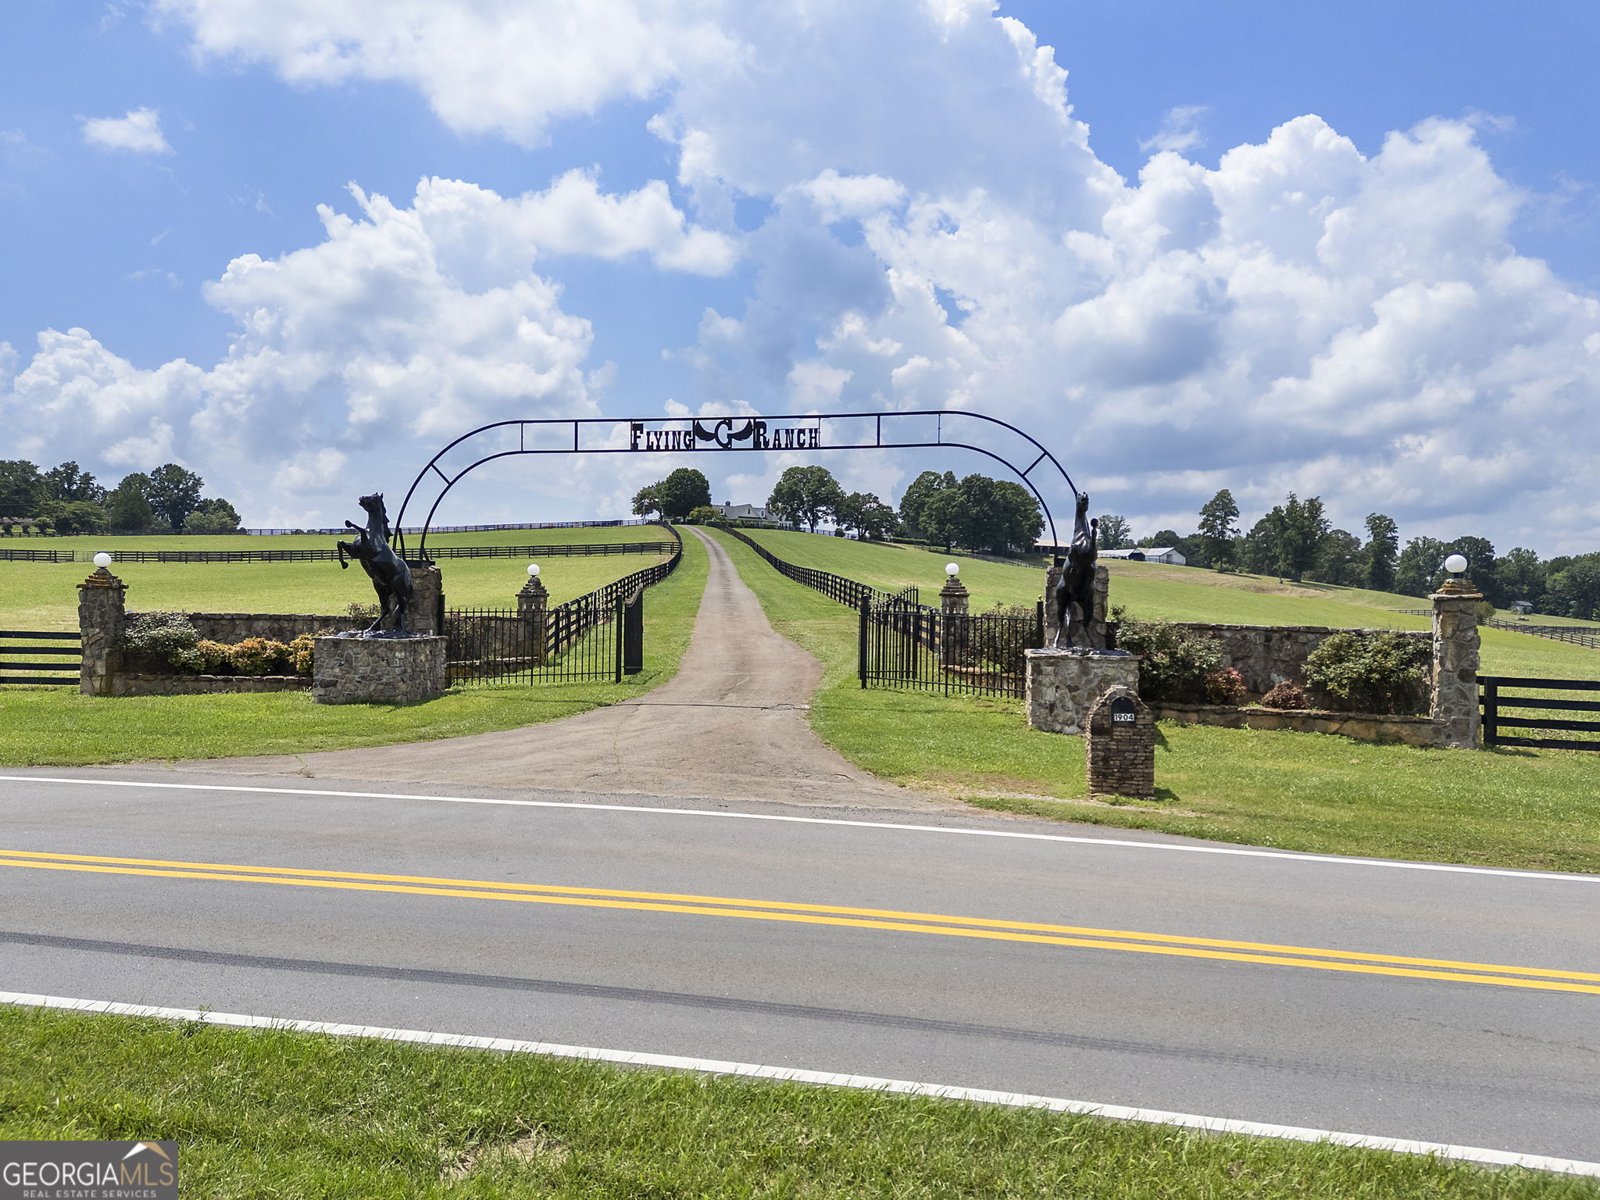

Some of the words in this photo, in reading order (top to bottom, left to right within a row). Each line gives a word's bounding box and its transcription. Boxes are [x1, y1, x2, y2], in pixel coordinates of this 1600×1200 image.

[631, 423, 694, 450] FLYING
[754, 420, 819, 449] RANCH
[1115, 713, 1134, 721] 1904
